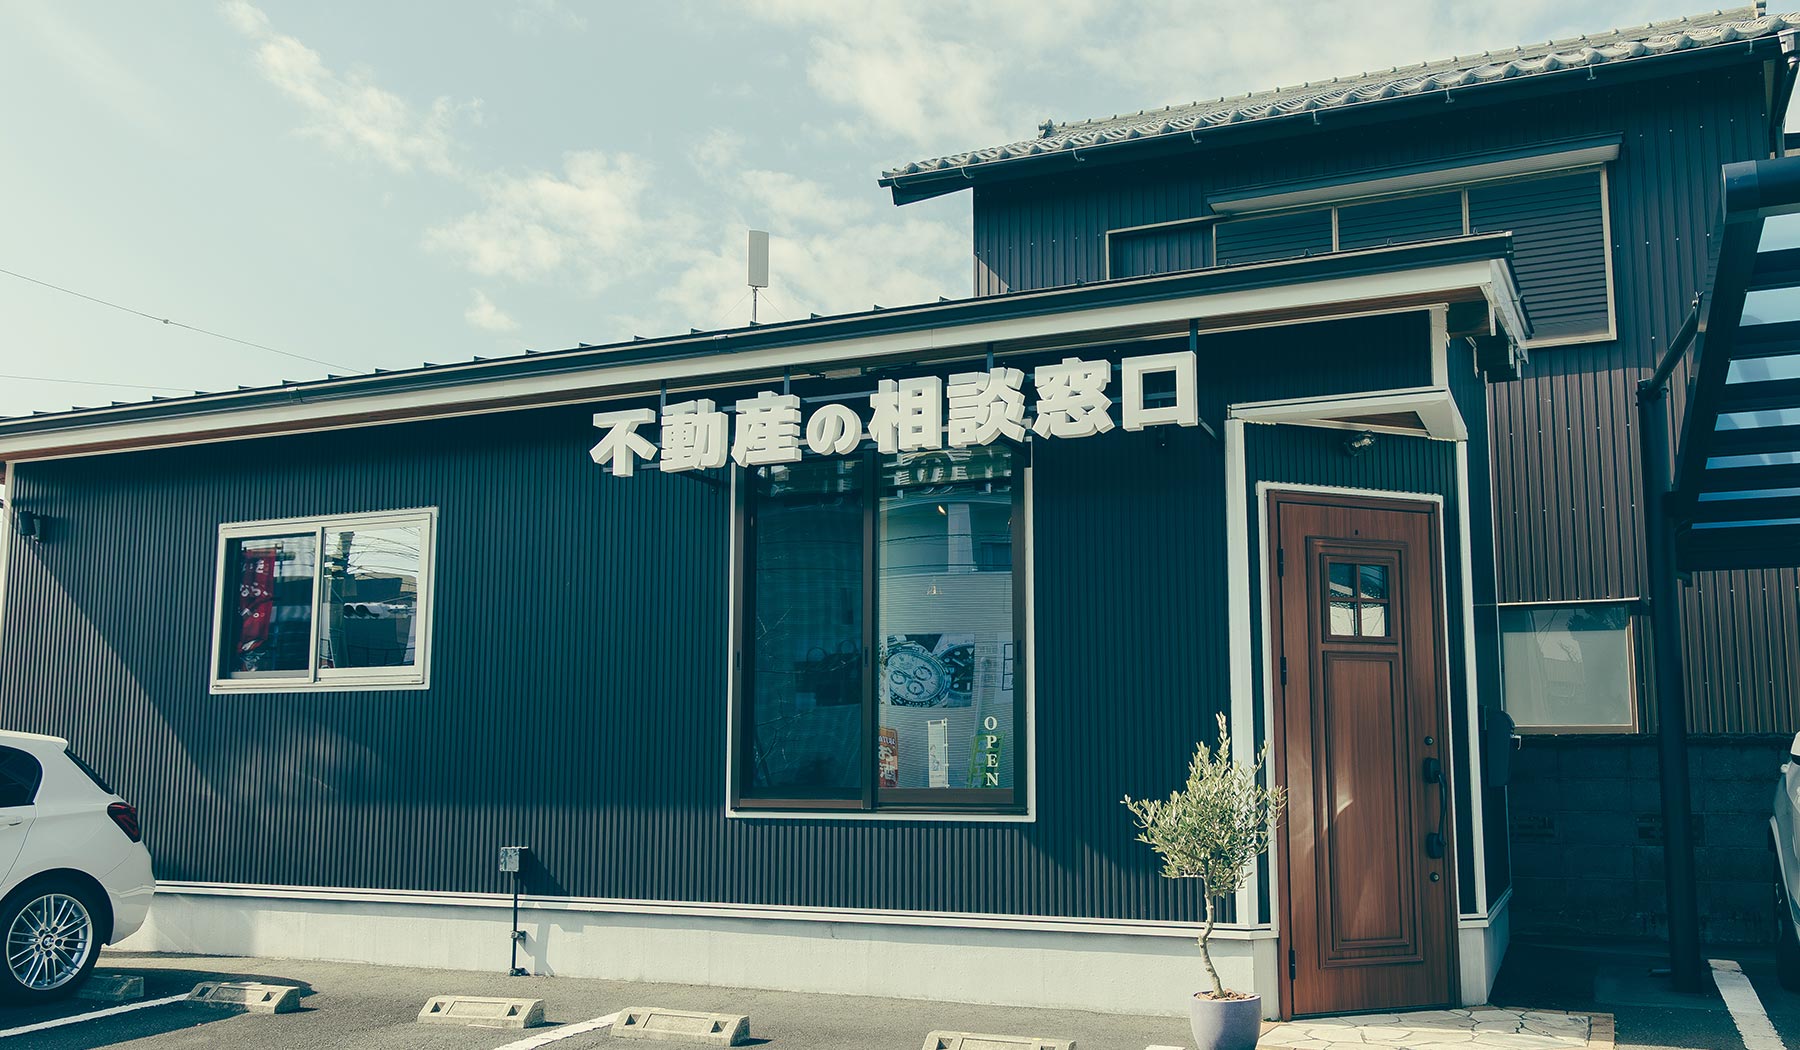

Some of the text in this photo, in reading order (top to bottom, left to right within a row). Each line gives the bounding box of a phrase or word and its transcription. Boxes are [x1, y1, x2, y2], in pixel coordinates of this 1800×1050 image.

[589, 350, 1199, 478] 不動産の相談窓口
[984, 716, 999, 786] OPEN
